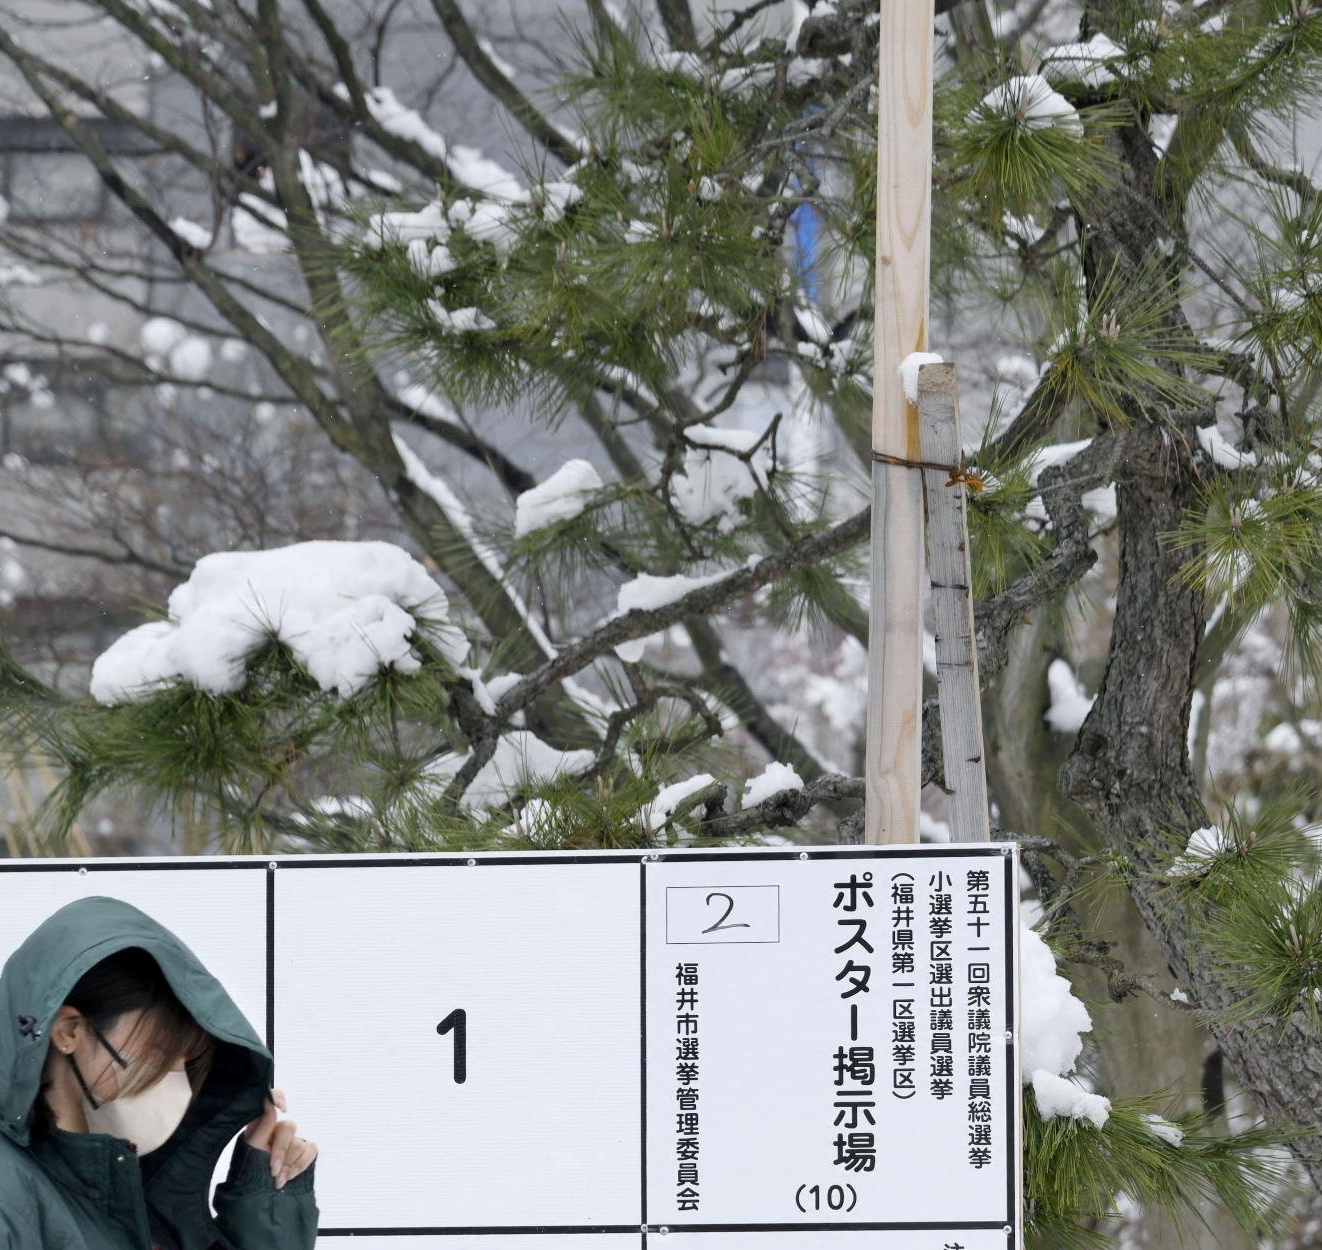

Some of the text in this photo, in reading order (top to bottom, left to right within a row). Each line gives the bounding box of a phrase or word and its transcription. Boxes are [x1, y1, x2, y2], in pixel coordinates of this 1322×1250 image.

[702, 893, 750, 933] 2
[833, 872, 876, 1172] ポスター掲示場
[891, 873, 916, 1099] （福井県第一区選挙区）
[929, 871, 953, 1100] 小選挙区選出議員選挙
[967, 870, 991, 1169] 第五十一回衆議院議員総選挙
[437, 1009, 466, 1084] 1
[676, 963, 699, 1210] 福井市選挙管理委員会
[796, 1184, 857, 1213] (10)
